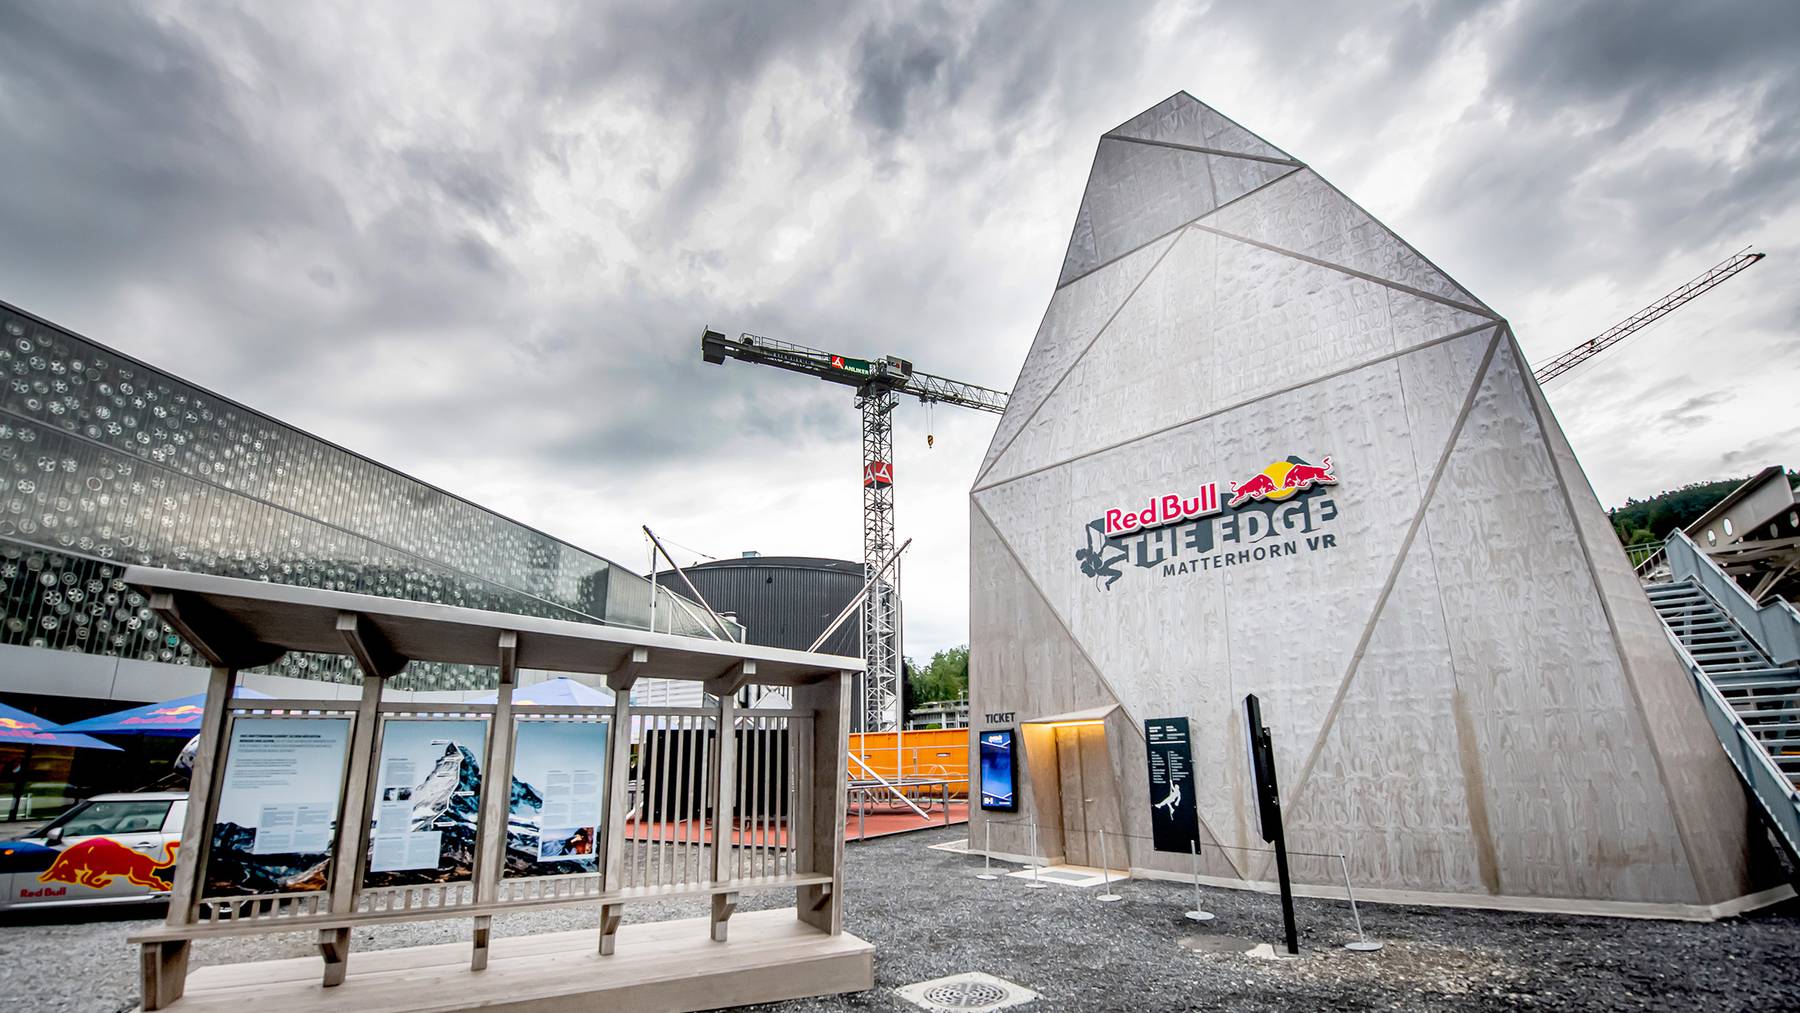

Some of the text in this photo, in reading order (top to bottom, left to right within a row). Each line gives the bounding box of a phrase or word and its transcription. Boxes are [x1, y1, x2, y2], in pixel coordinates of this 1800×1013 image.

[1106, 483, 1217, 533] Red Bull
[1121, 496, 1335, 566] THE EDGE
[1163, 534, 1337, 578] MATTERHORN VR
[985, 712, 1015, 723] TICKET
[20, 887, 66, 897] Red Bull
